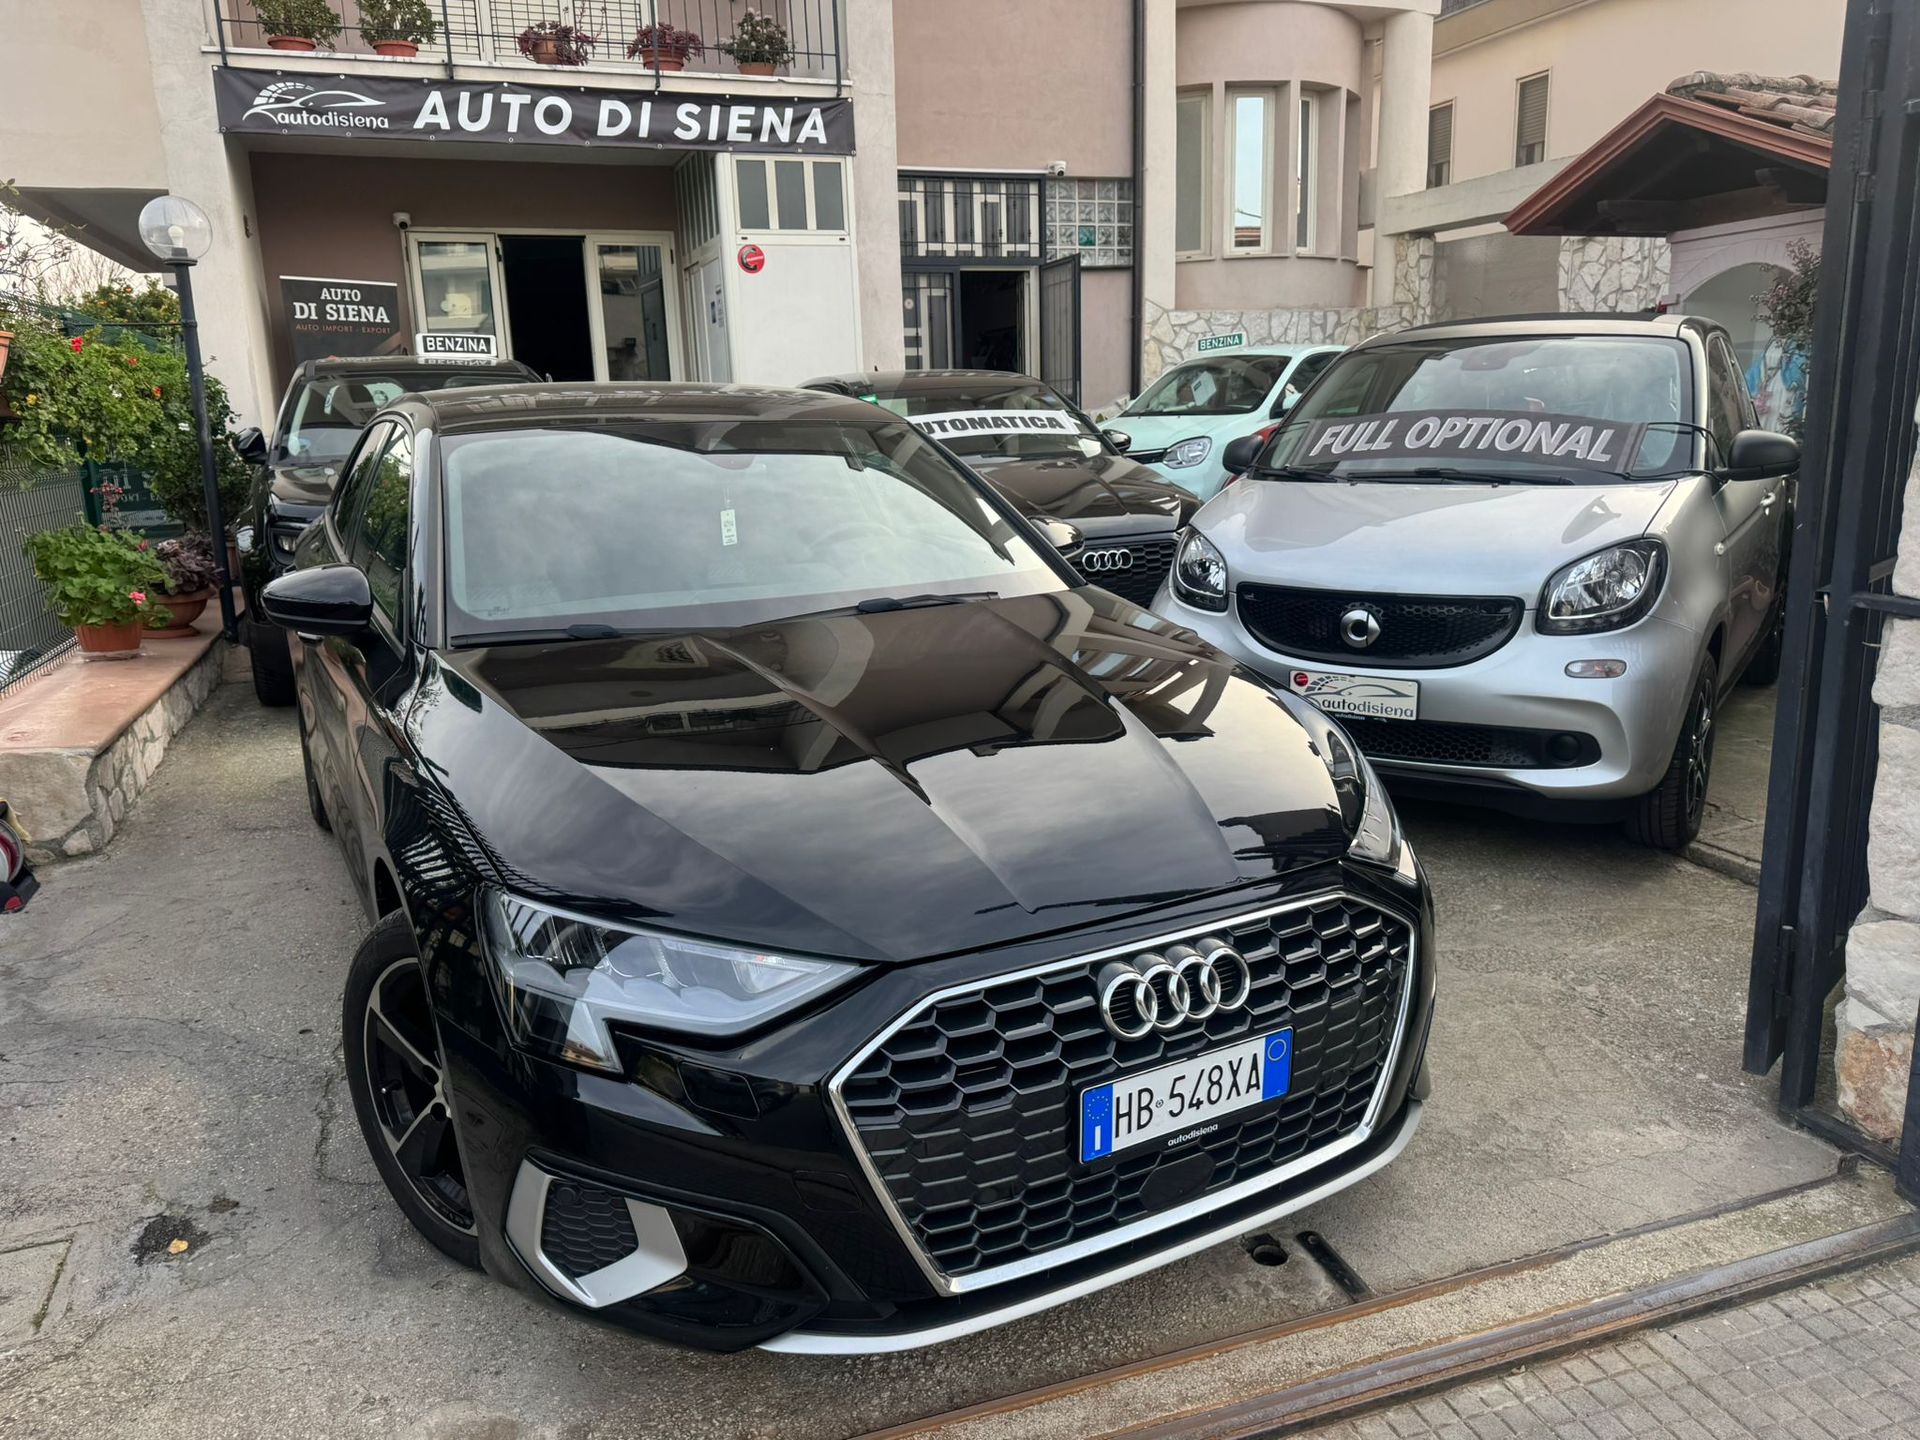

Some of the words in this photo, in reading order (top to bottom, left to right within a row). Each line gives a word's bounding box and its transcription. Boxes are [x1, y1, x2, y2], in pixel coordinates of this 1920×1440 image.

[277, 110, 389, 129] autodisiena
[413, 91, 573, 135] AUTO
[597, 99, 651, 138] DI
[673, 103, 828, 145] SIENA
[320, 288, 361, 302] AUTO
[293, 302, 318, 320] DI
[325, 303, 391, 324] SIENA
[296, 323, 320, 332] AUTO
[322, 325, 354, 333] IMPORT
[361, 326, 391, 335] EXPORT
[426, 336, 488, 352] BENZINA
[1200, 335, 1240, 350] BENZINA
[913, 415, 1066, 435] UTOMATICA
[1309, 418, 1399, 457] FULL
[1404, 416, 1616, 462] OPTIONAL
[1321, 698, 1414, 718] autodisiena
[1115, 1087, 1154, 1138] HB
[1168, 1053, 1261, 1118] 548XA
[1167, 1123, 1219, 1147] autodisiena
